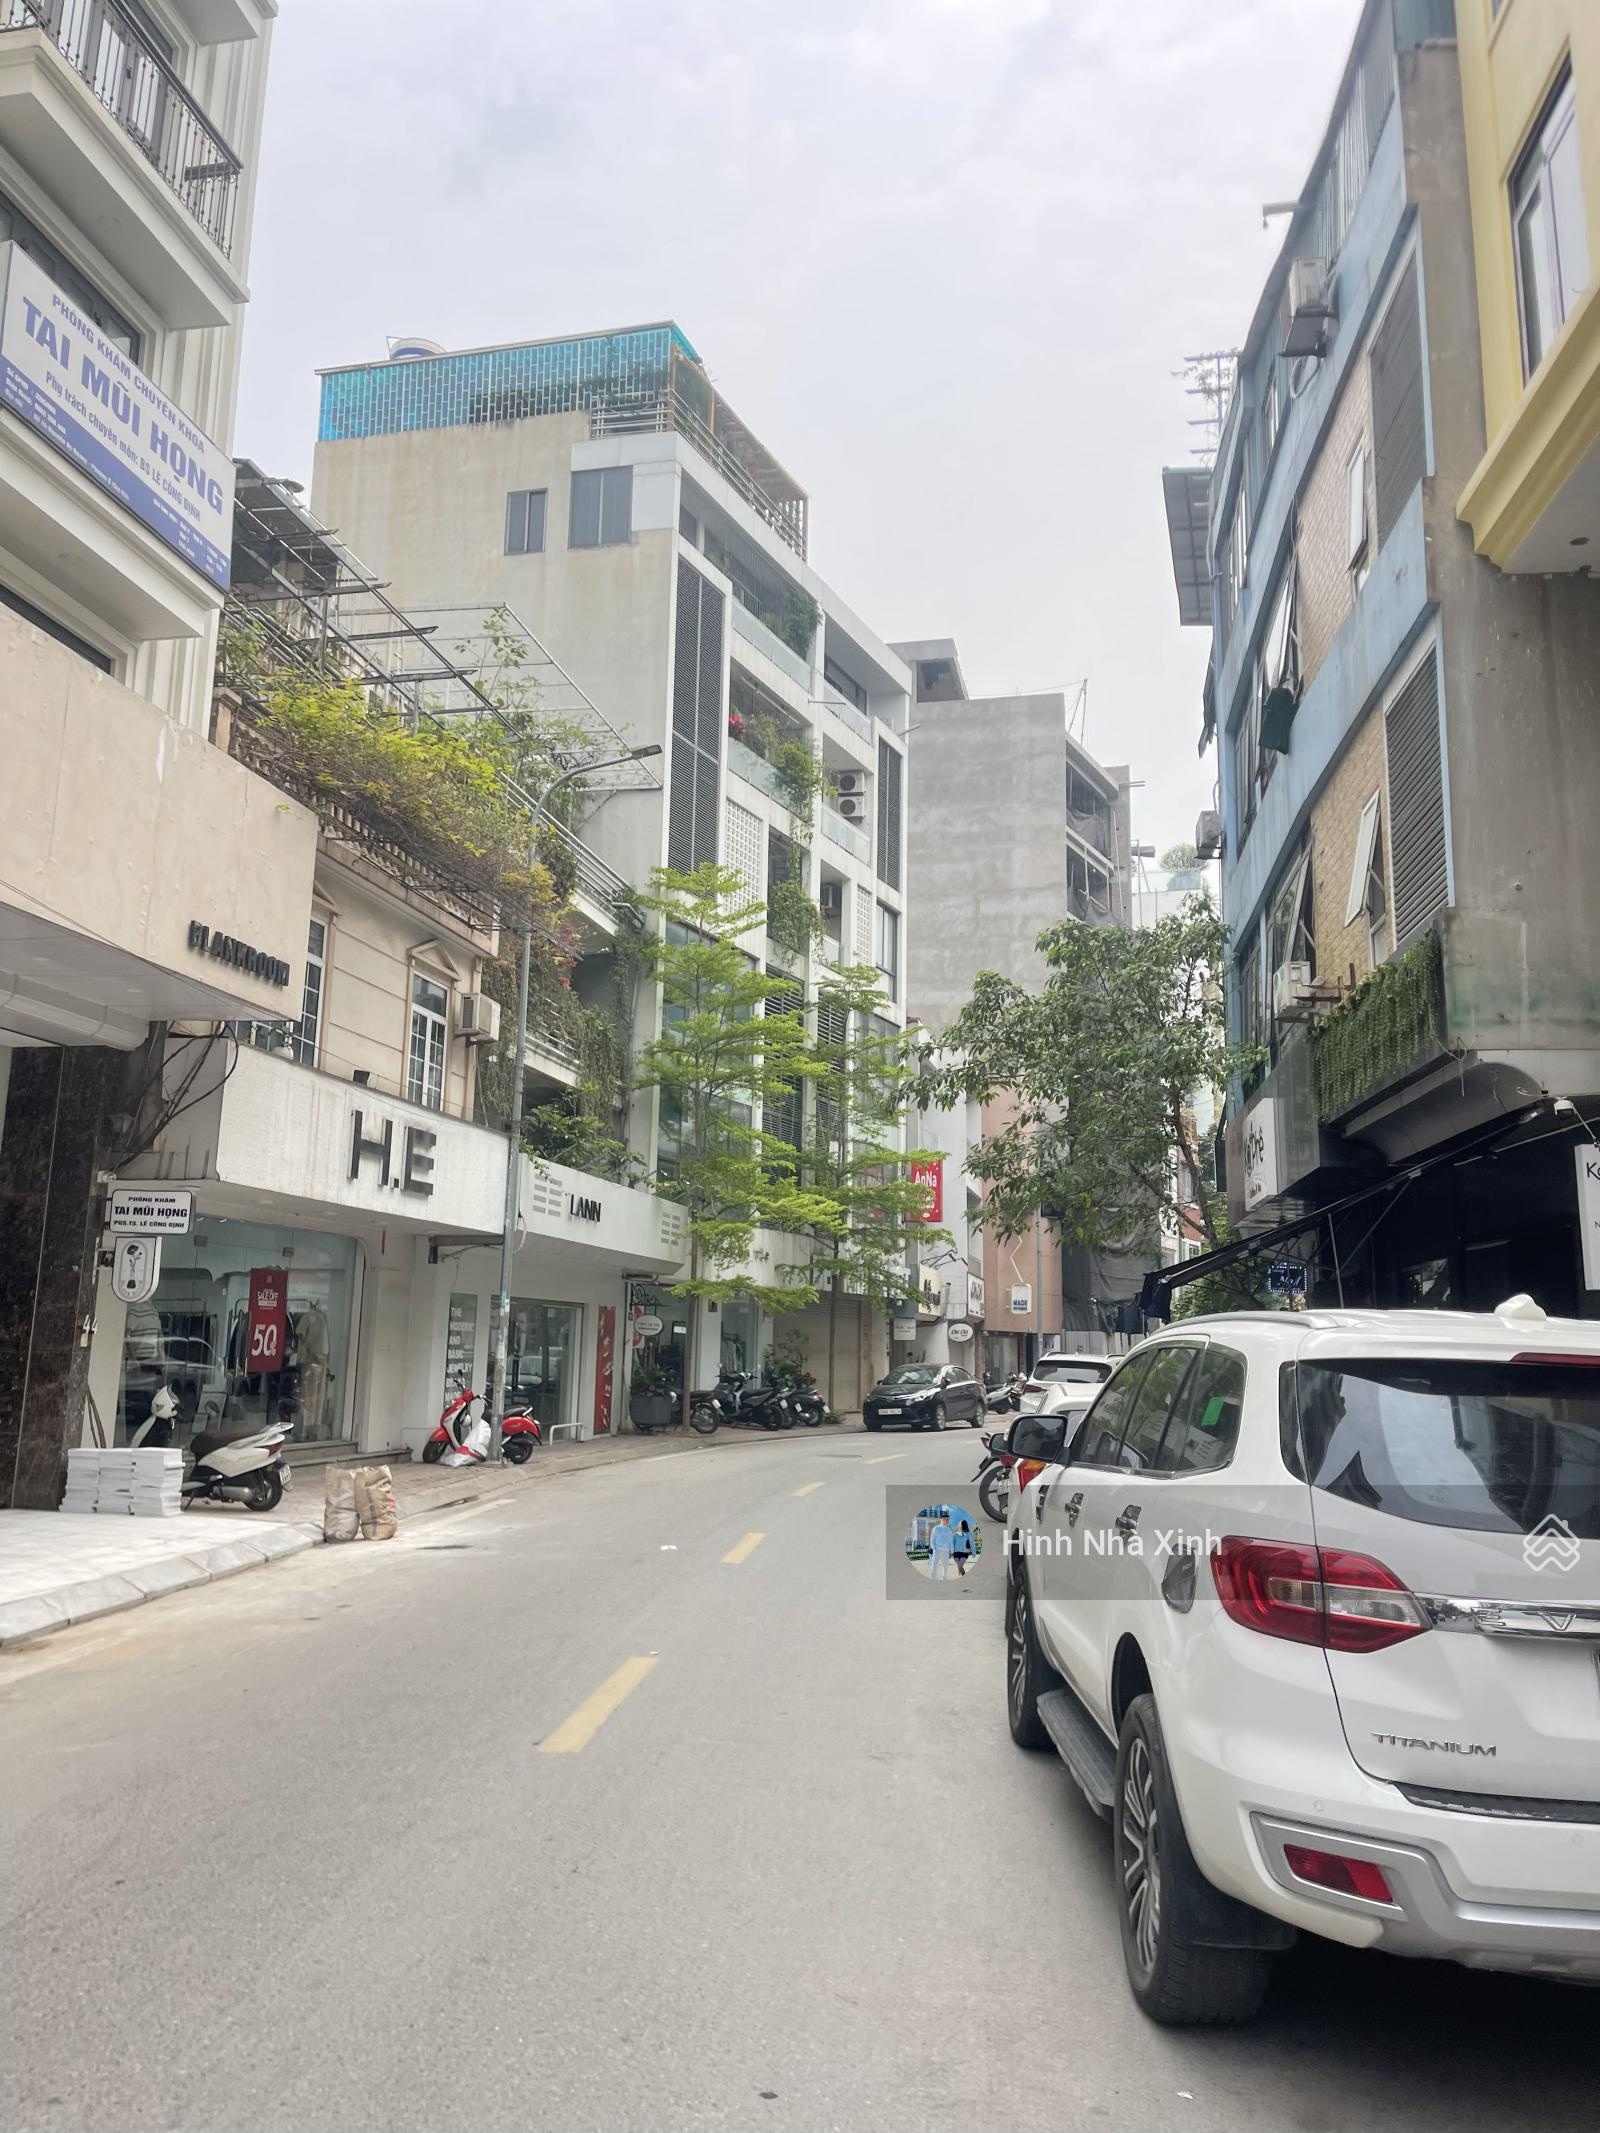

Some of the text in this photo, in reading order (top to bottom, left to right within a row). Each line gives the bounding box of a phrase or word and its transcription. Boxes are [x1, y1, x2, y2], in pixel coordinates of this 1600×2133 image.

[23, 295, 70, 370] TAI
[81, 353, 140, 437] MŨI
[150, 419, 223, 515] HỌNG
[97, 337, 131, 380] KHÁM
[178, 416, 205, 455] KHOA
[140, 457, 150, 476] BS
[189, 919, 290, 987] BLANKROOM
[350, 1109, 437, 1196] H.E
[915, 1170, 937, 1188] AnNa
[115, 1205, 188, 1219] TAI MŨI HỌNG
[570, 1193, 602, 1222] LANN
[450, 1307, 462, 1317] THE
[449, 1335, 461, 1345] AND
[1371, 1732, 1497, 1757] TITANIUM
